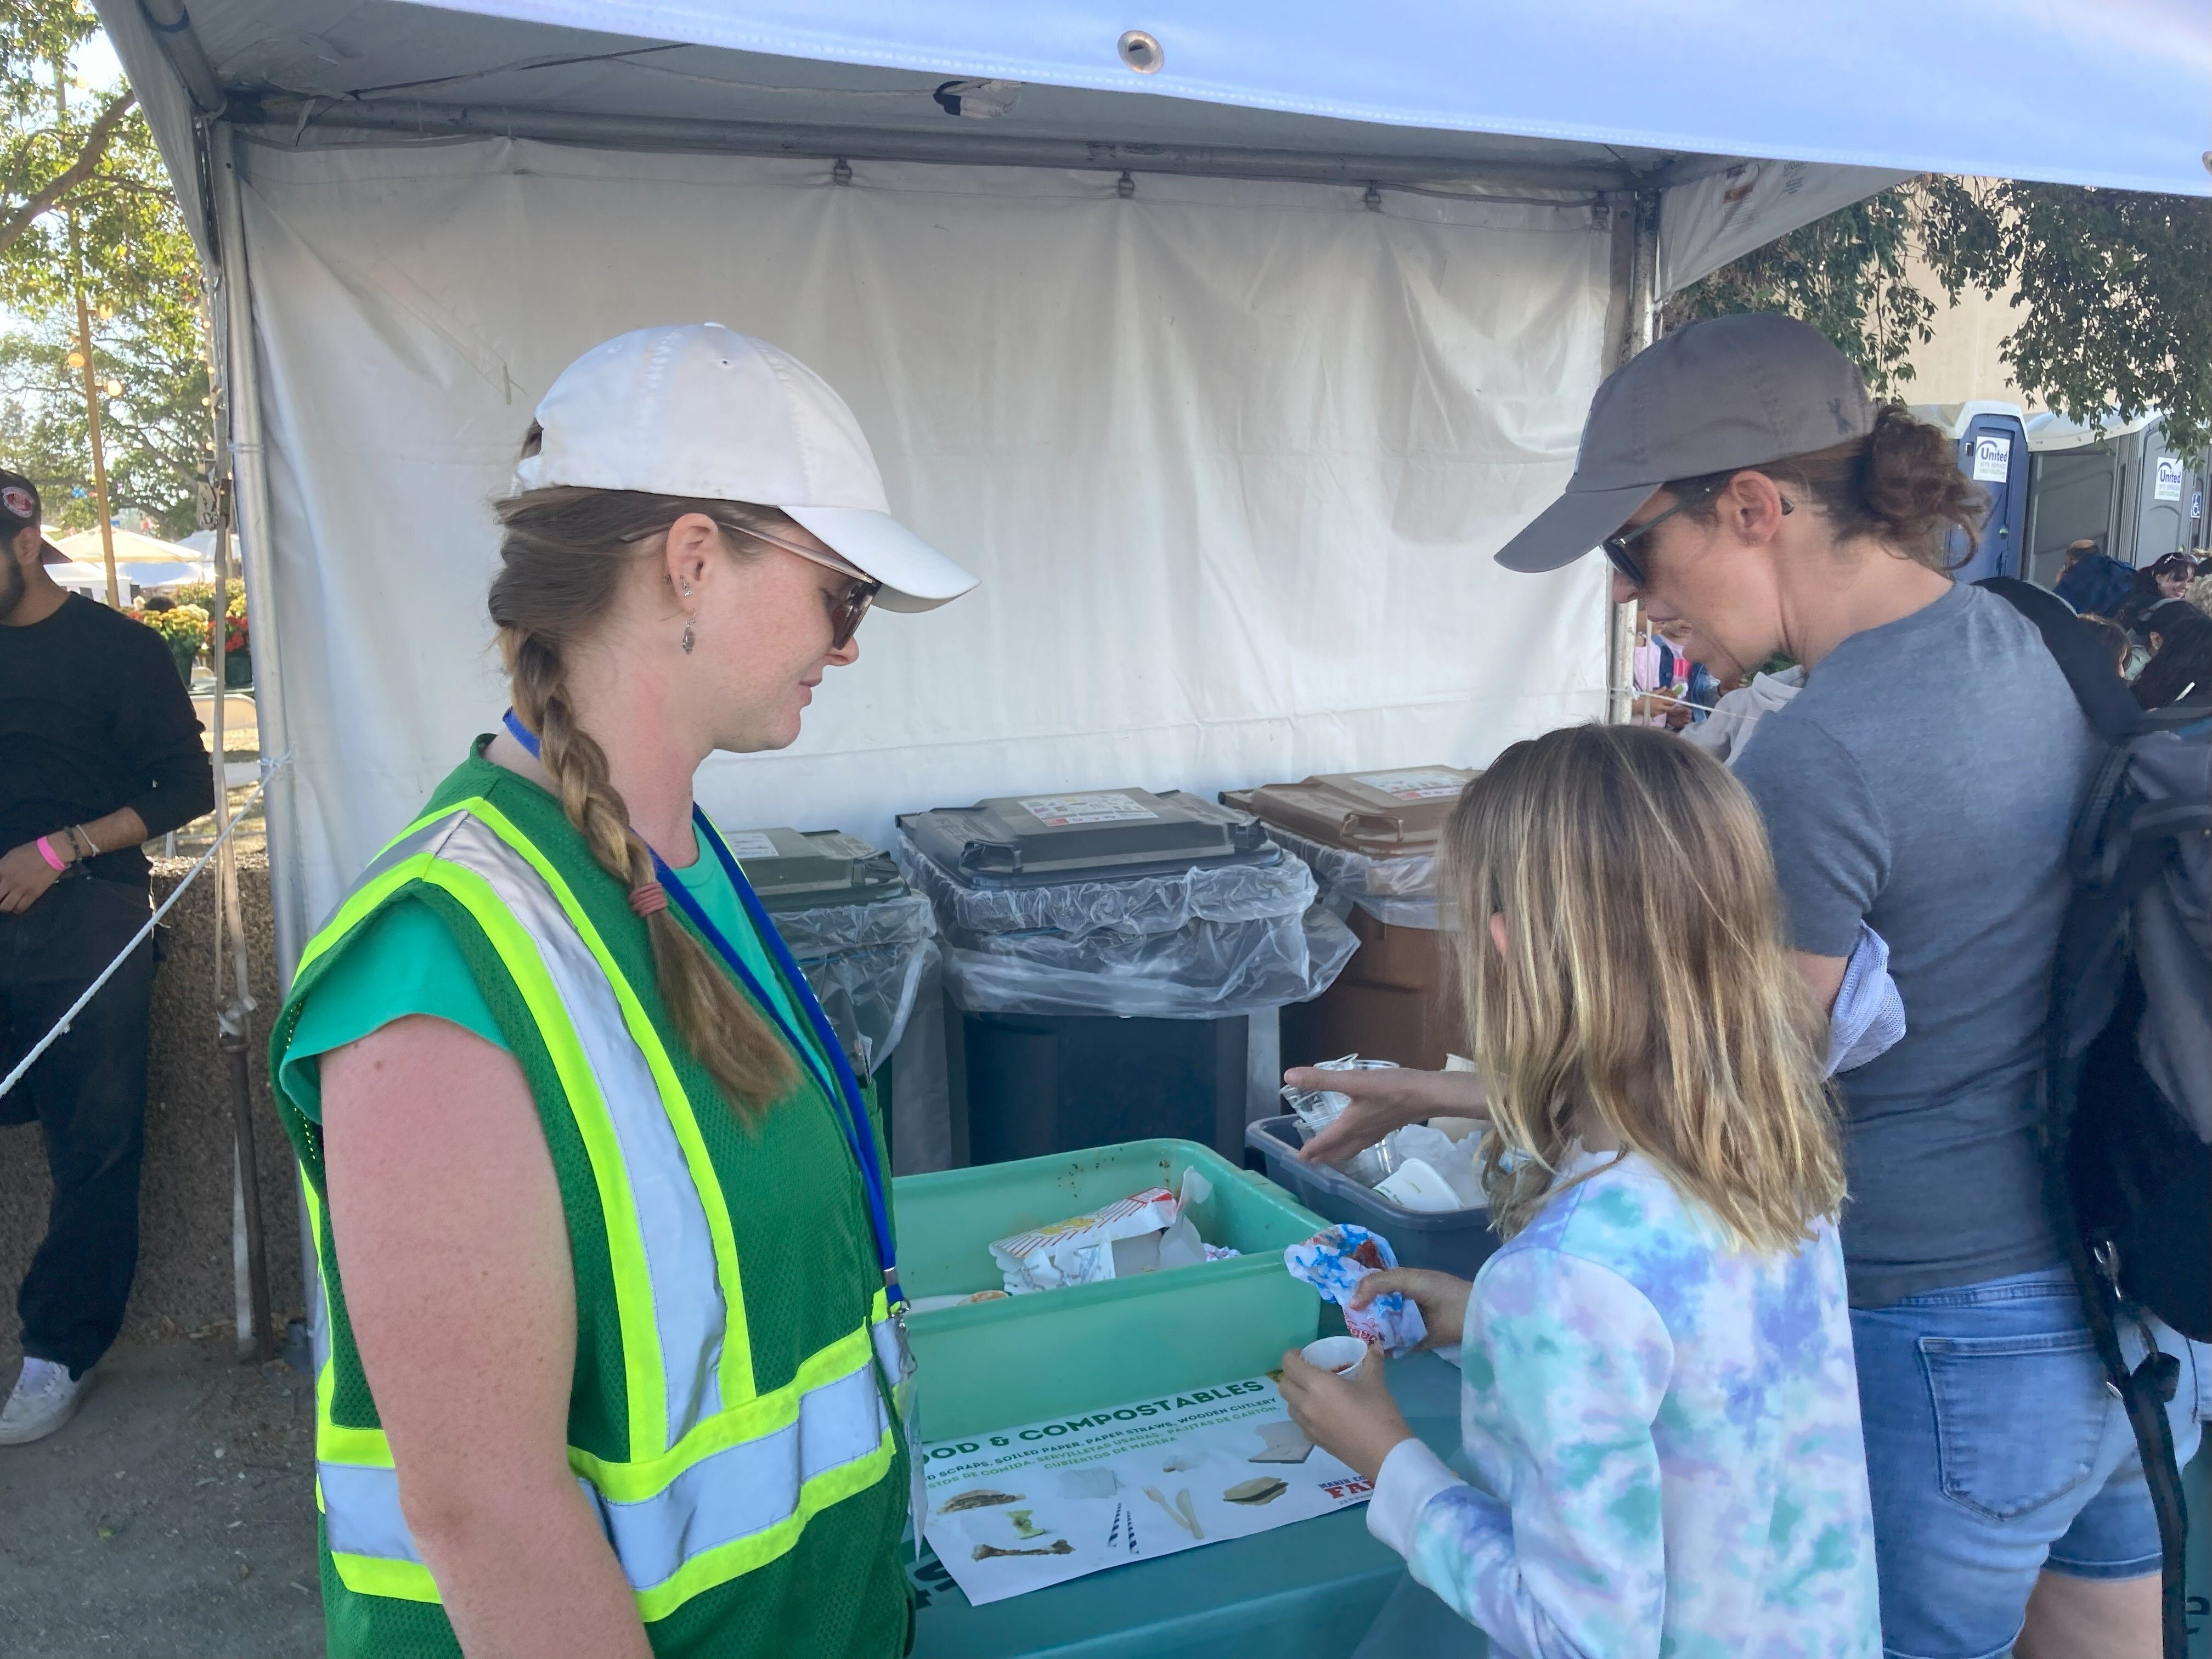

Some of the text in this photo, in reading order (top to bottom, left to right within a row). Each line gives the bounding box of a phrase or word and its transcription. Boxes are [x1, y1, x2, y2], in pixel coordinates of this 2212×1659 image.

[1981, 447, 2008, 462] United
[2160, 469, 2181, 483] United
[923, 1381, 1265, 1465] OD & COMPOSTABLES
[995, 1449, 1039, 1464] SOILED
[1086, 1431, 1124, 1444] PAPER
[1177, 1408, 1228, 1424] WOODEN
[1229, 1397, 1276, 1412] CUTLERY
[926, 1476, 960, 1489] STOS
[1037, 1442, 1111, 1463] SERVILLETAS
[1167, 1420, 1215, 1434] PAJITAS
[1215, 1415, 1232, 1424] DE
[1044, 1451, 1111, 1469] CUBIERTOS
[1130, 1436, 1177, 1449] MADERA
[1318, 1479, 1351, 1489] MARIN
